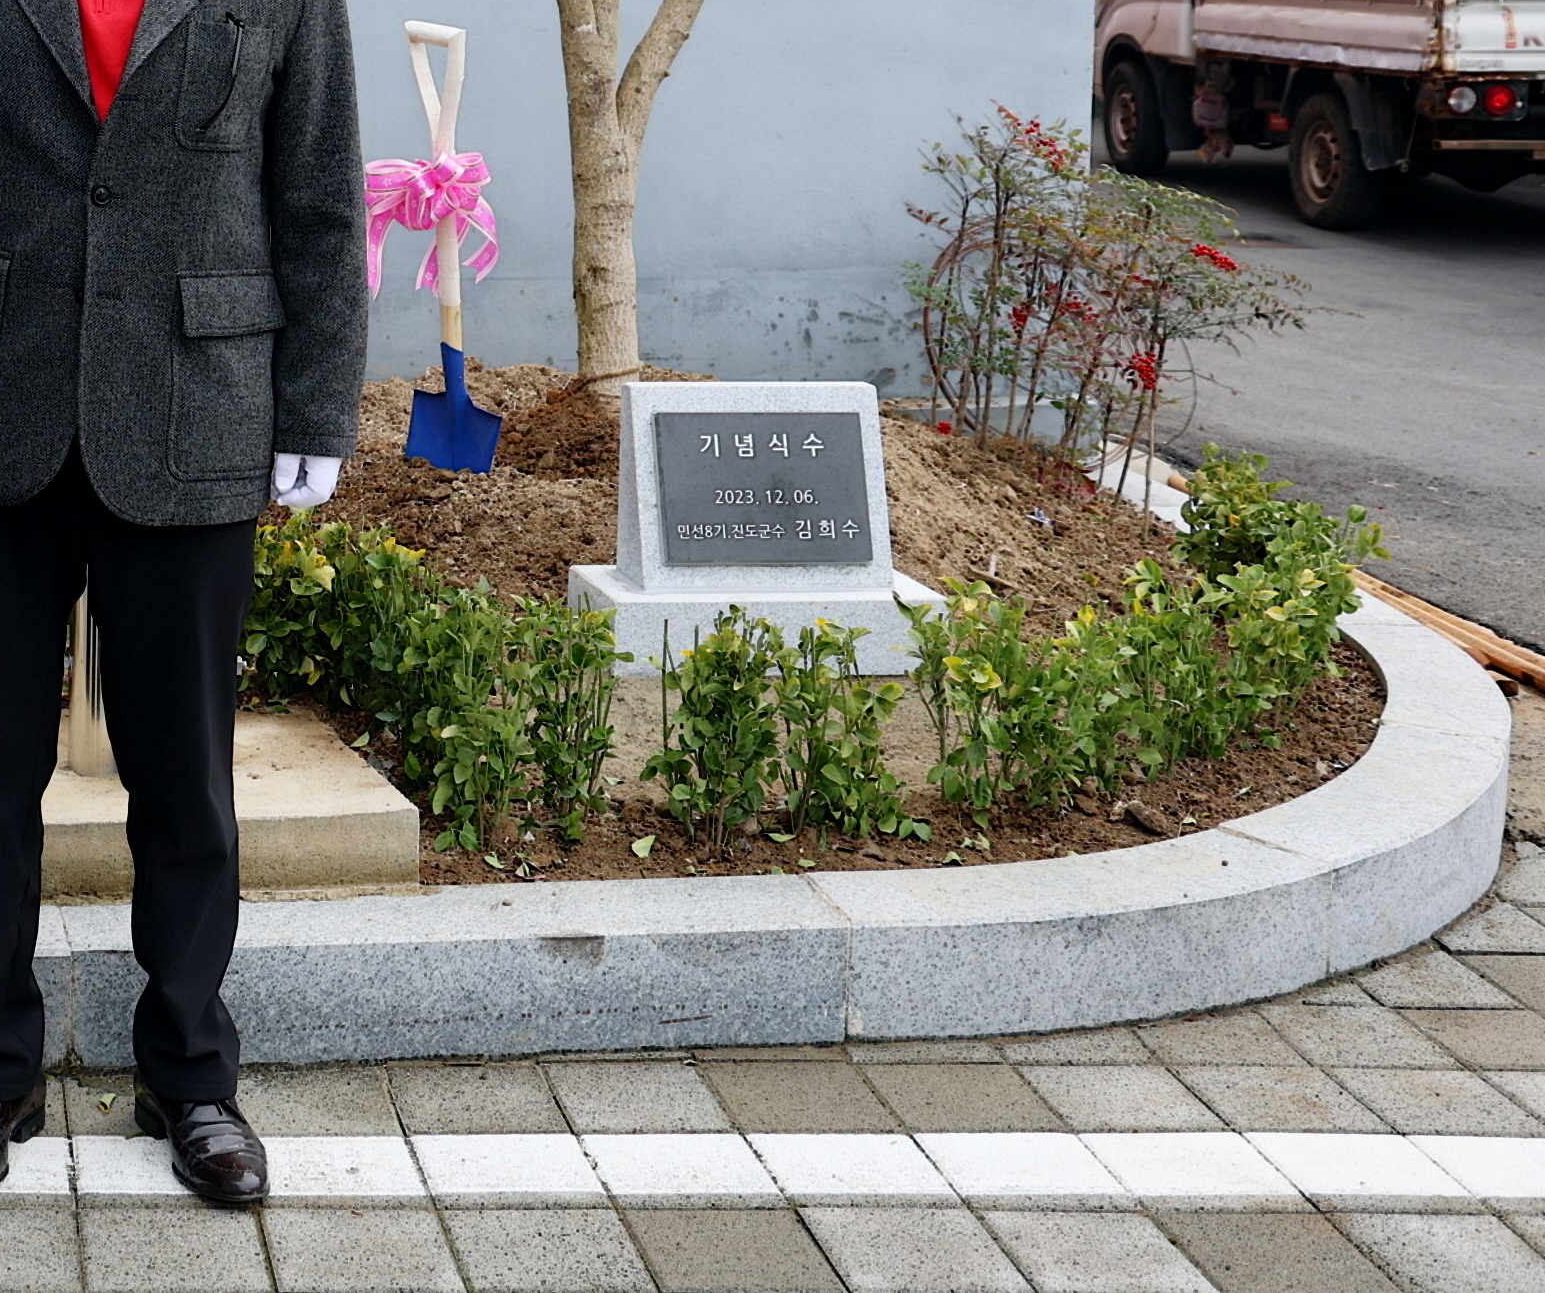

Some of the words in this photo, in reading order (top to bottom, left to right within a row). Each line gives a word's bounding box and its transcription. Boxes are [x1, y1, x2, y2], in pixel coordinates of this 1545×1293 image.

[715, 490, 760, 504] 2023.
[765, 490, 789, 504] 12.
[793, 489, 819, 504] 06.
